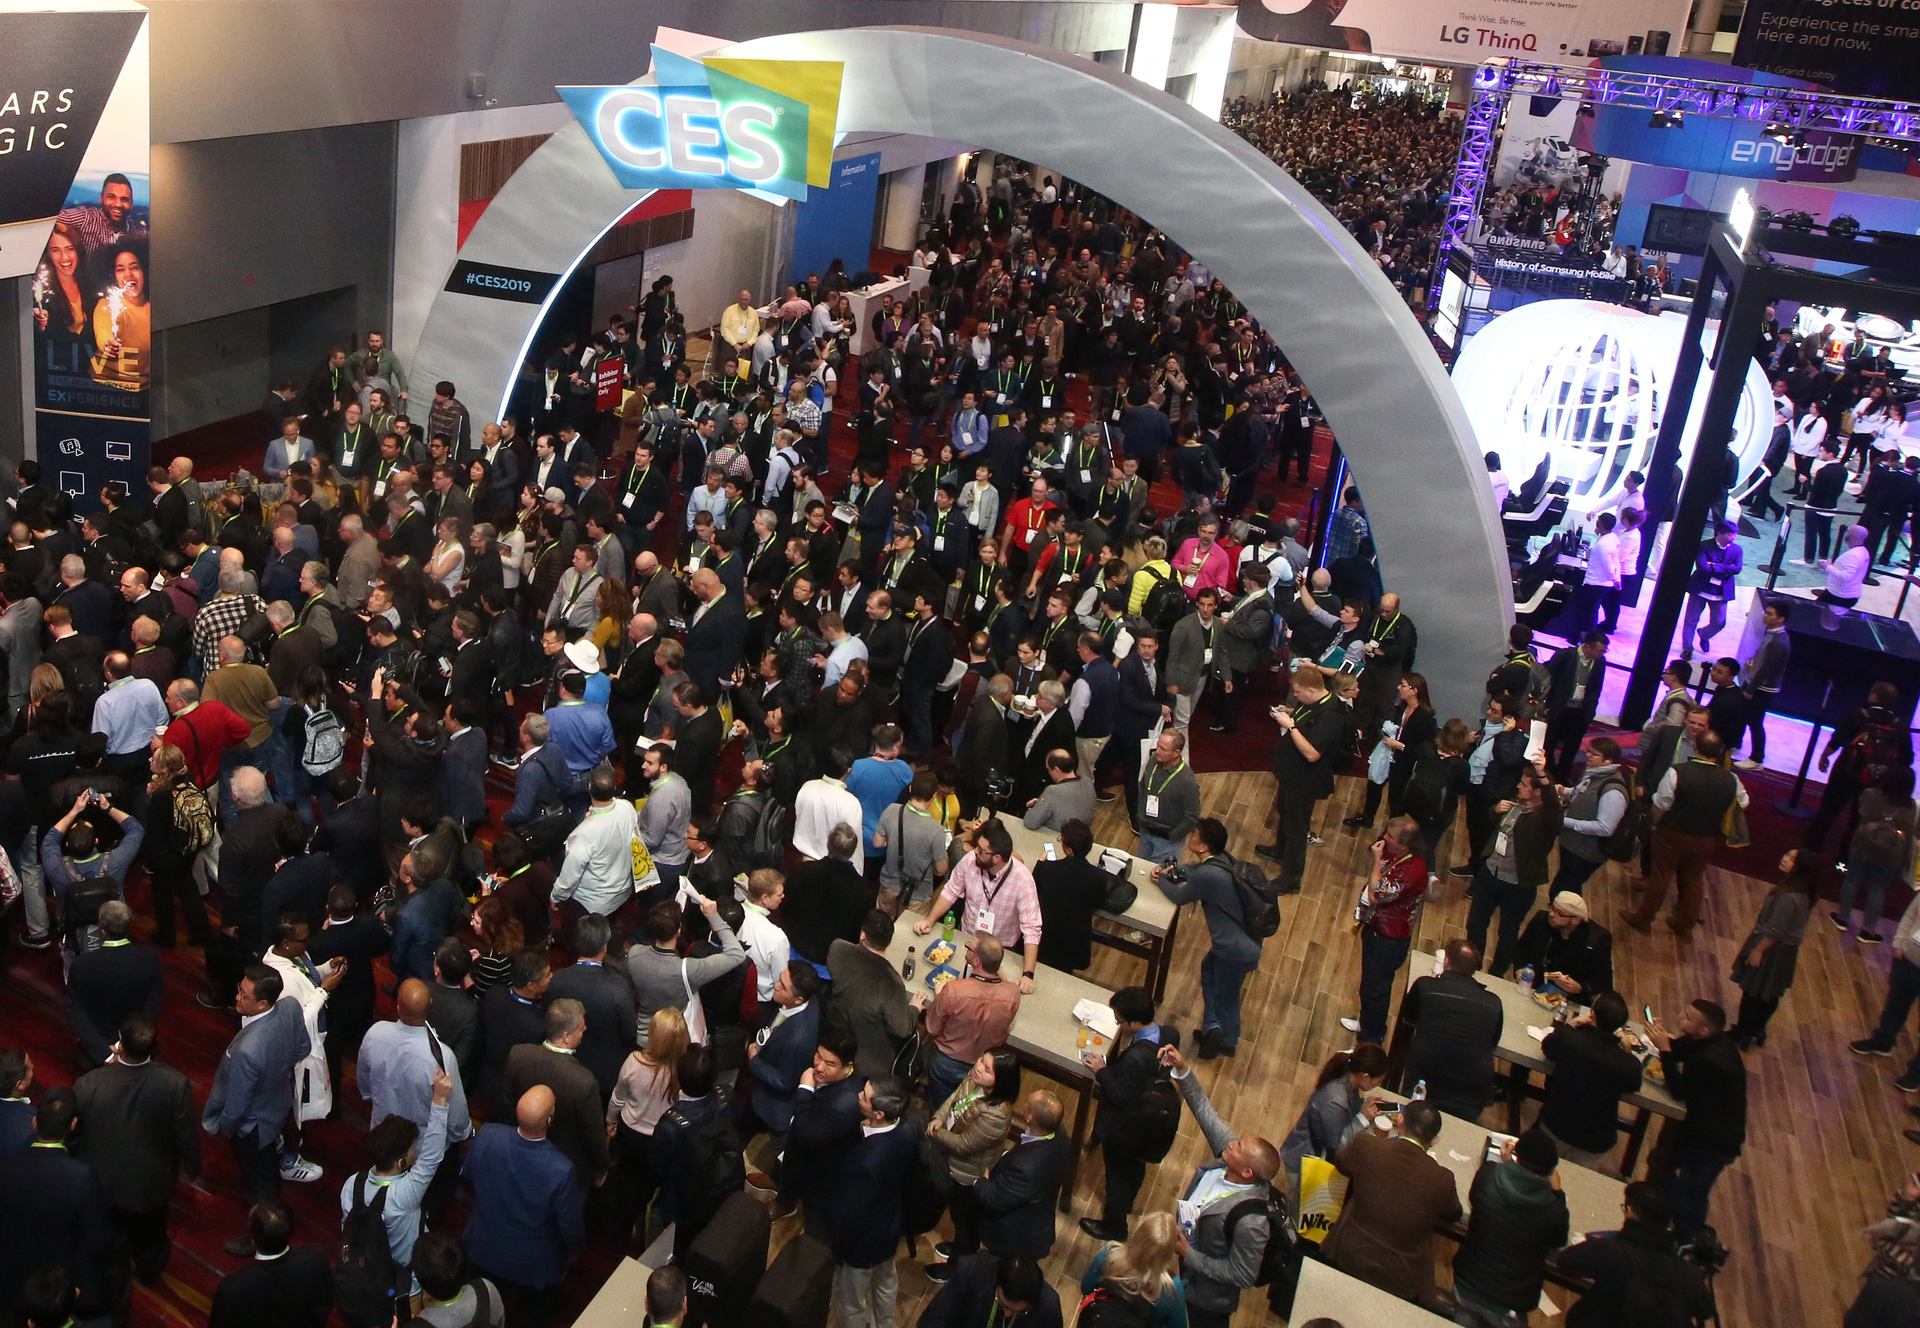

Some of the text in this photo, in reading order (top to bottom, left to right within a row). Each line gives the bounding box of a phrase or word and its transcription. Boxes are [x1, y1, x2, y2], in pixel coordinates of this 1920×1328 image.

[1458, 12, 1527, 27] Think Wise. Be Free.
[1760, 12, 1849, 32] Experience
[1853, 21, 1880, 34] the
[1439, 25, 1537, 52] LG ThinQ
[1756, 28, 1872, 51] Here and now.
[1774, 65, 1805, 77] Grand
[1806, 69, 1837, 82] Lobby
[0, 88, 74, 117] ARS
[597, 89, 783, 182] CES
[1731, 136, 1855, 172] engadget
[1495, 258, 1616, 281] History of Samsung Mobile
[465, 272, 532, 292] #CES2019
[47, 339, 140, 379] LIVE
[598, 378, 617, 388] Entrance
[599, 370, 618, 379] Exhibitor
[48, 389, 141, 409] EXPERIENCE
